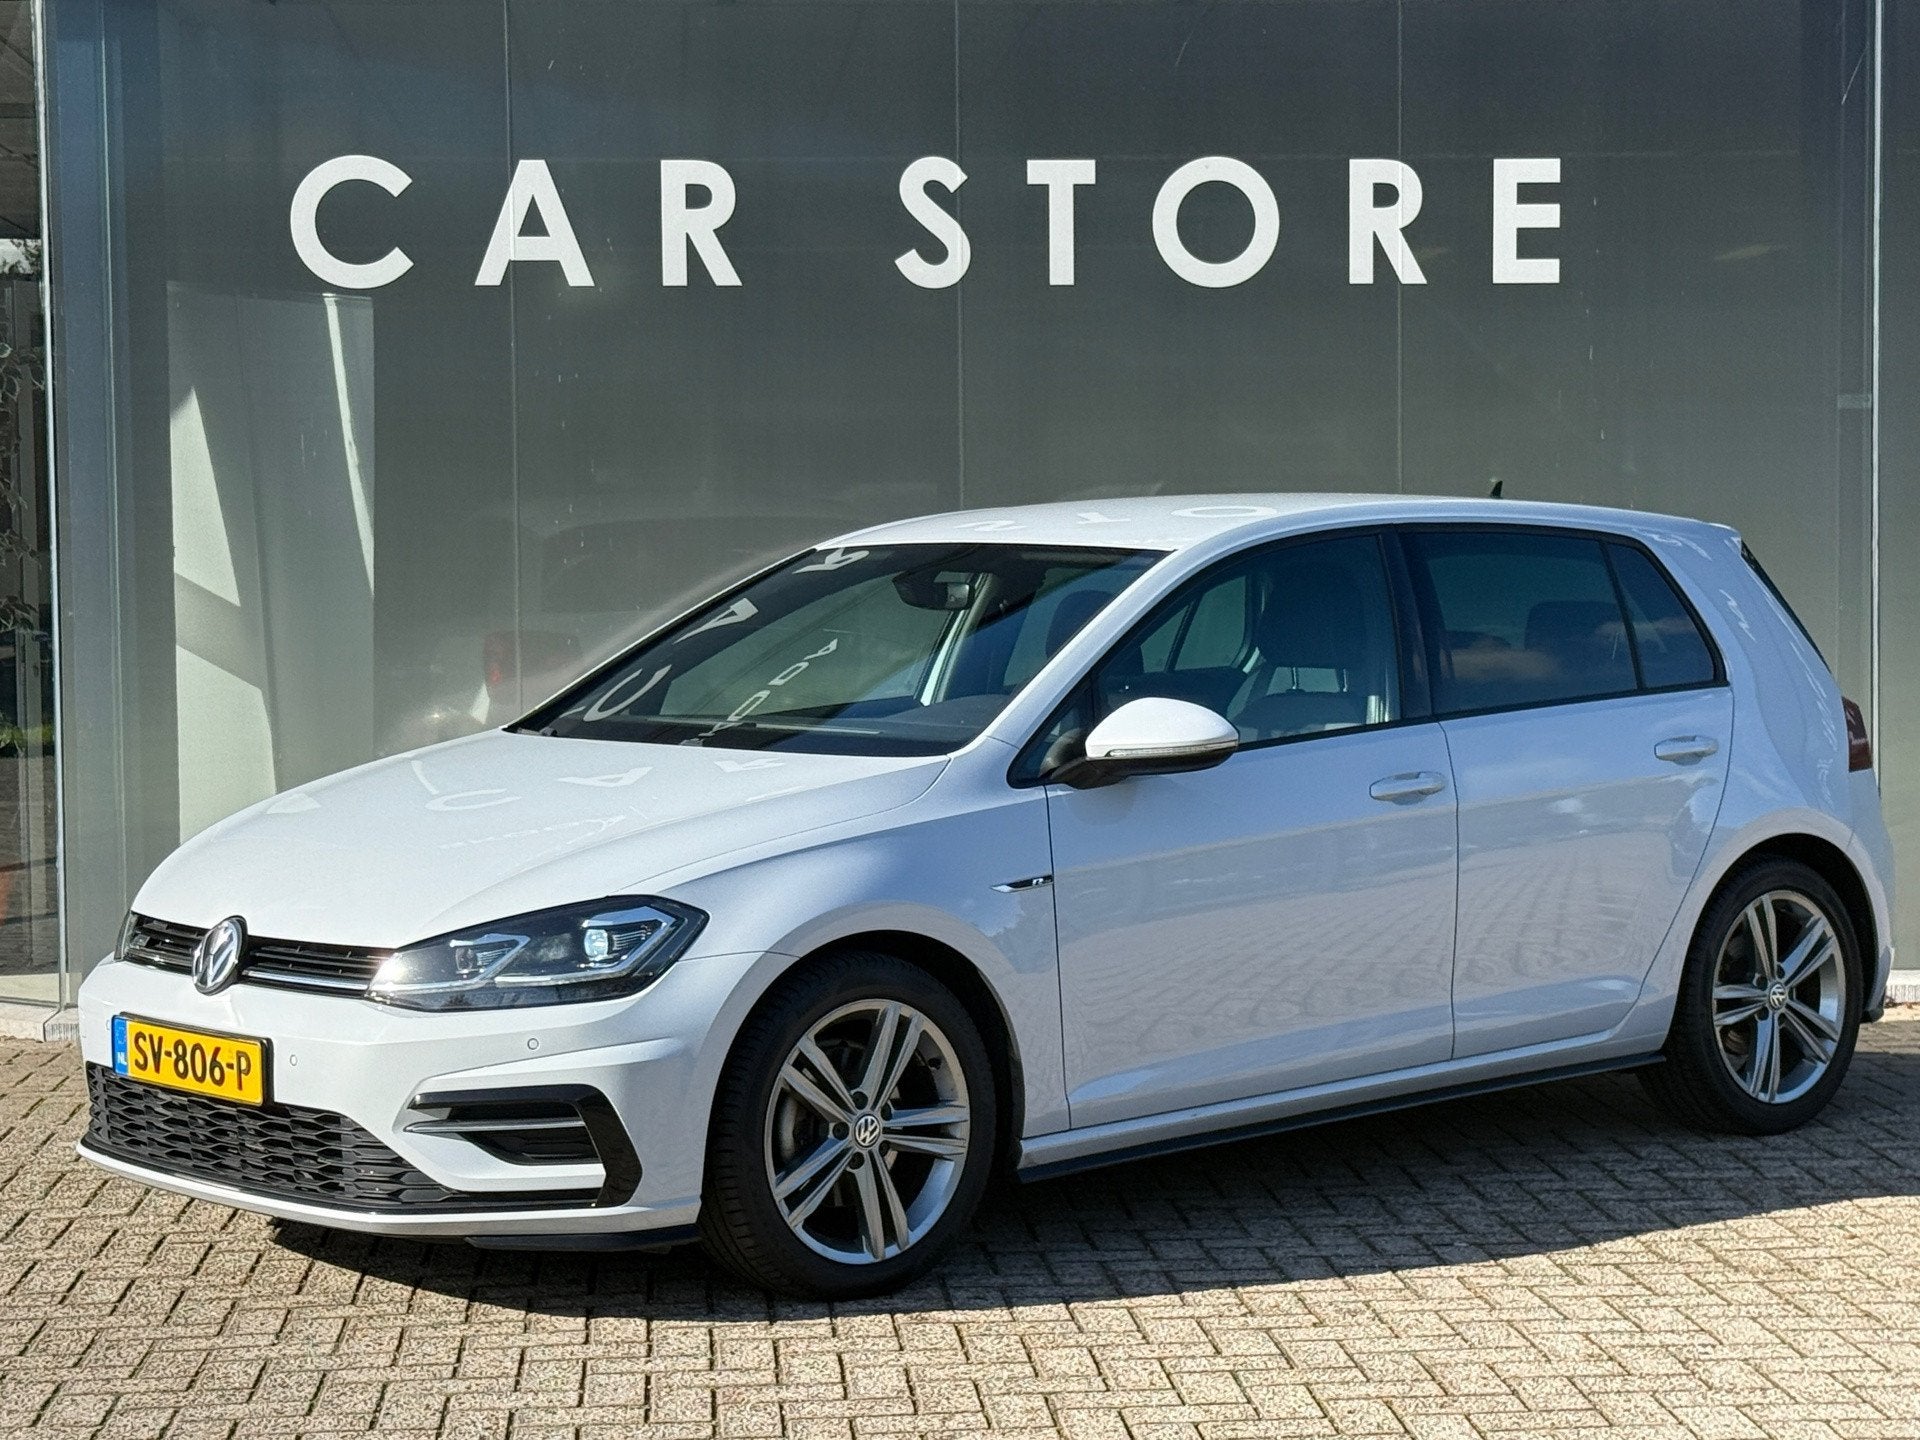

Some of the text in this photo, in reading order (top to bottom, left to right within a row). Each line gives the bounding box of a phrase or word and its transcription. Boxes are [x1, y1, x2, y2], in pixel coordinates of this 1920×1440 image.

[290, 155, 1561, 288] CAR STORE
[117, 1051, 127, 1065] NL
[134, 1031, 251, 1091] SV-806-P
